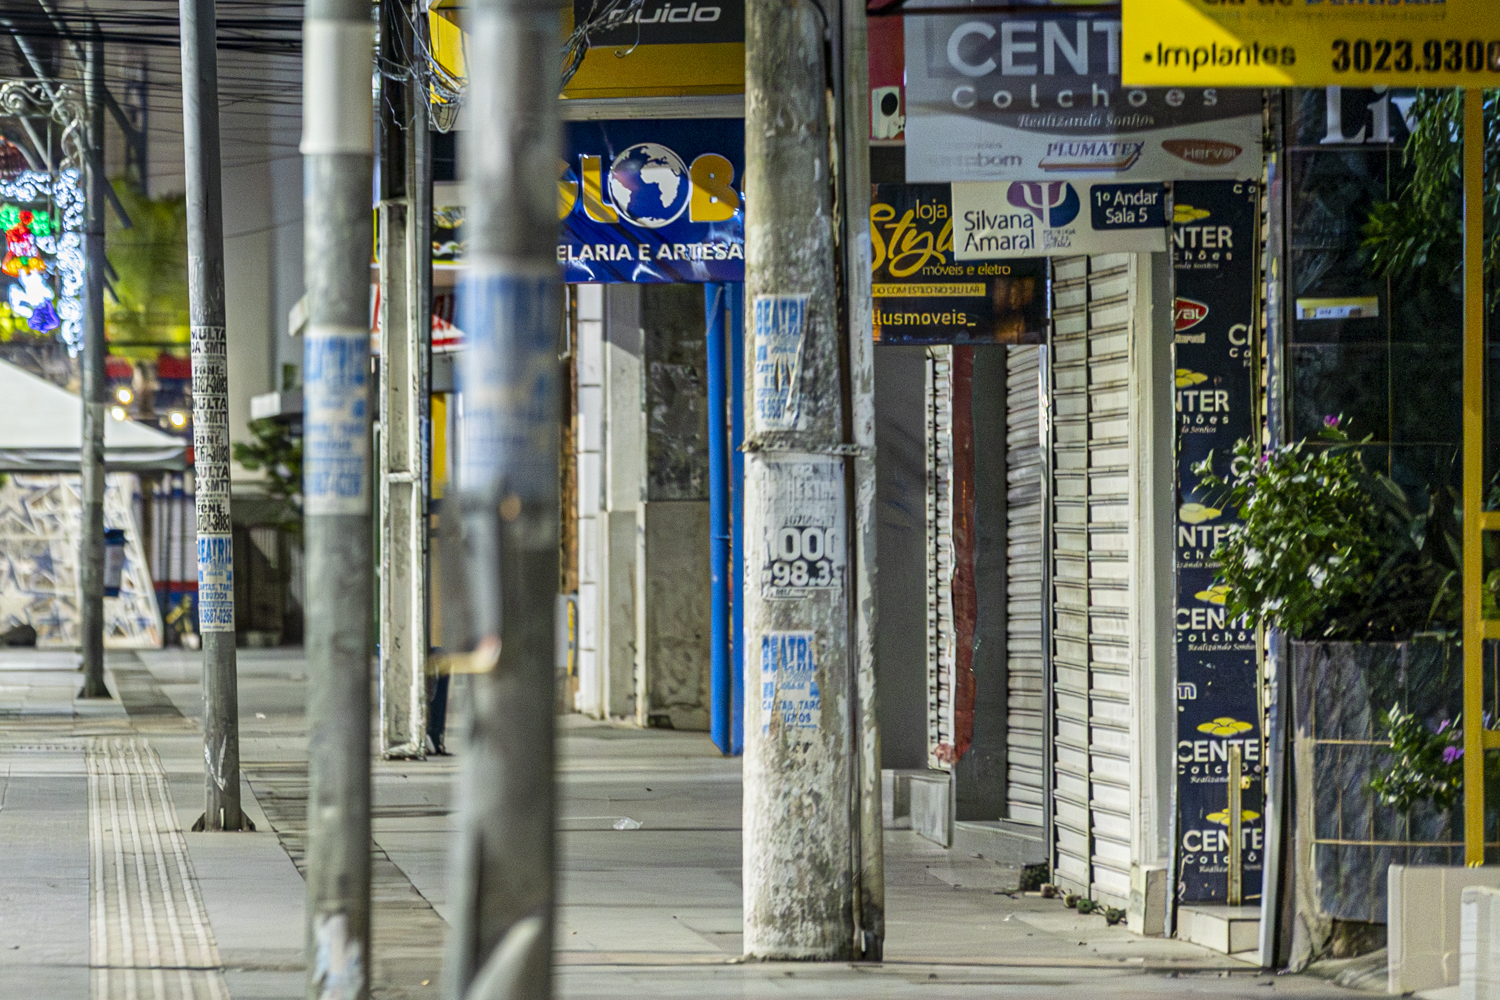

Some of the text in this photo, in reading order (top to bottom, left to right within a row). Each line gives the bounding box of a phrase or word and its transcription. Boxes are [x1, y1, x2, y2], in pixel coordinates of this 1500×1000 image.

[1157, 41, 1297, 73] Implantes
[1046, 139, 1145, 157] PLUMATEX
[1113, 188, 1160, 207] Andar
[915, 199, 948, 225] loja
[963, 209, 1035, 232] Silvana
[1105, 207, 1149, 225] Sala 5
[964, 228, 1036, 252] Amaral
[638, 243, 650, 261] E
[921, 261, 1011, 276] móveis e eletro
[191, 327, 227, 341] MULTA
[761, 634, 818, 673] BEATRI
